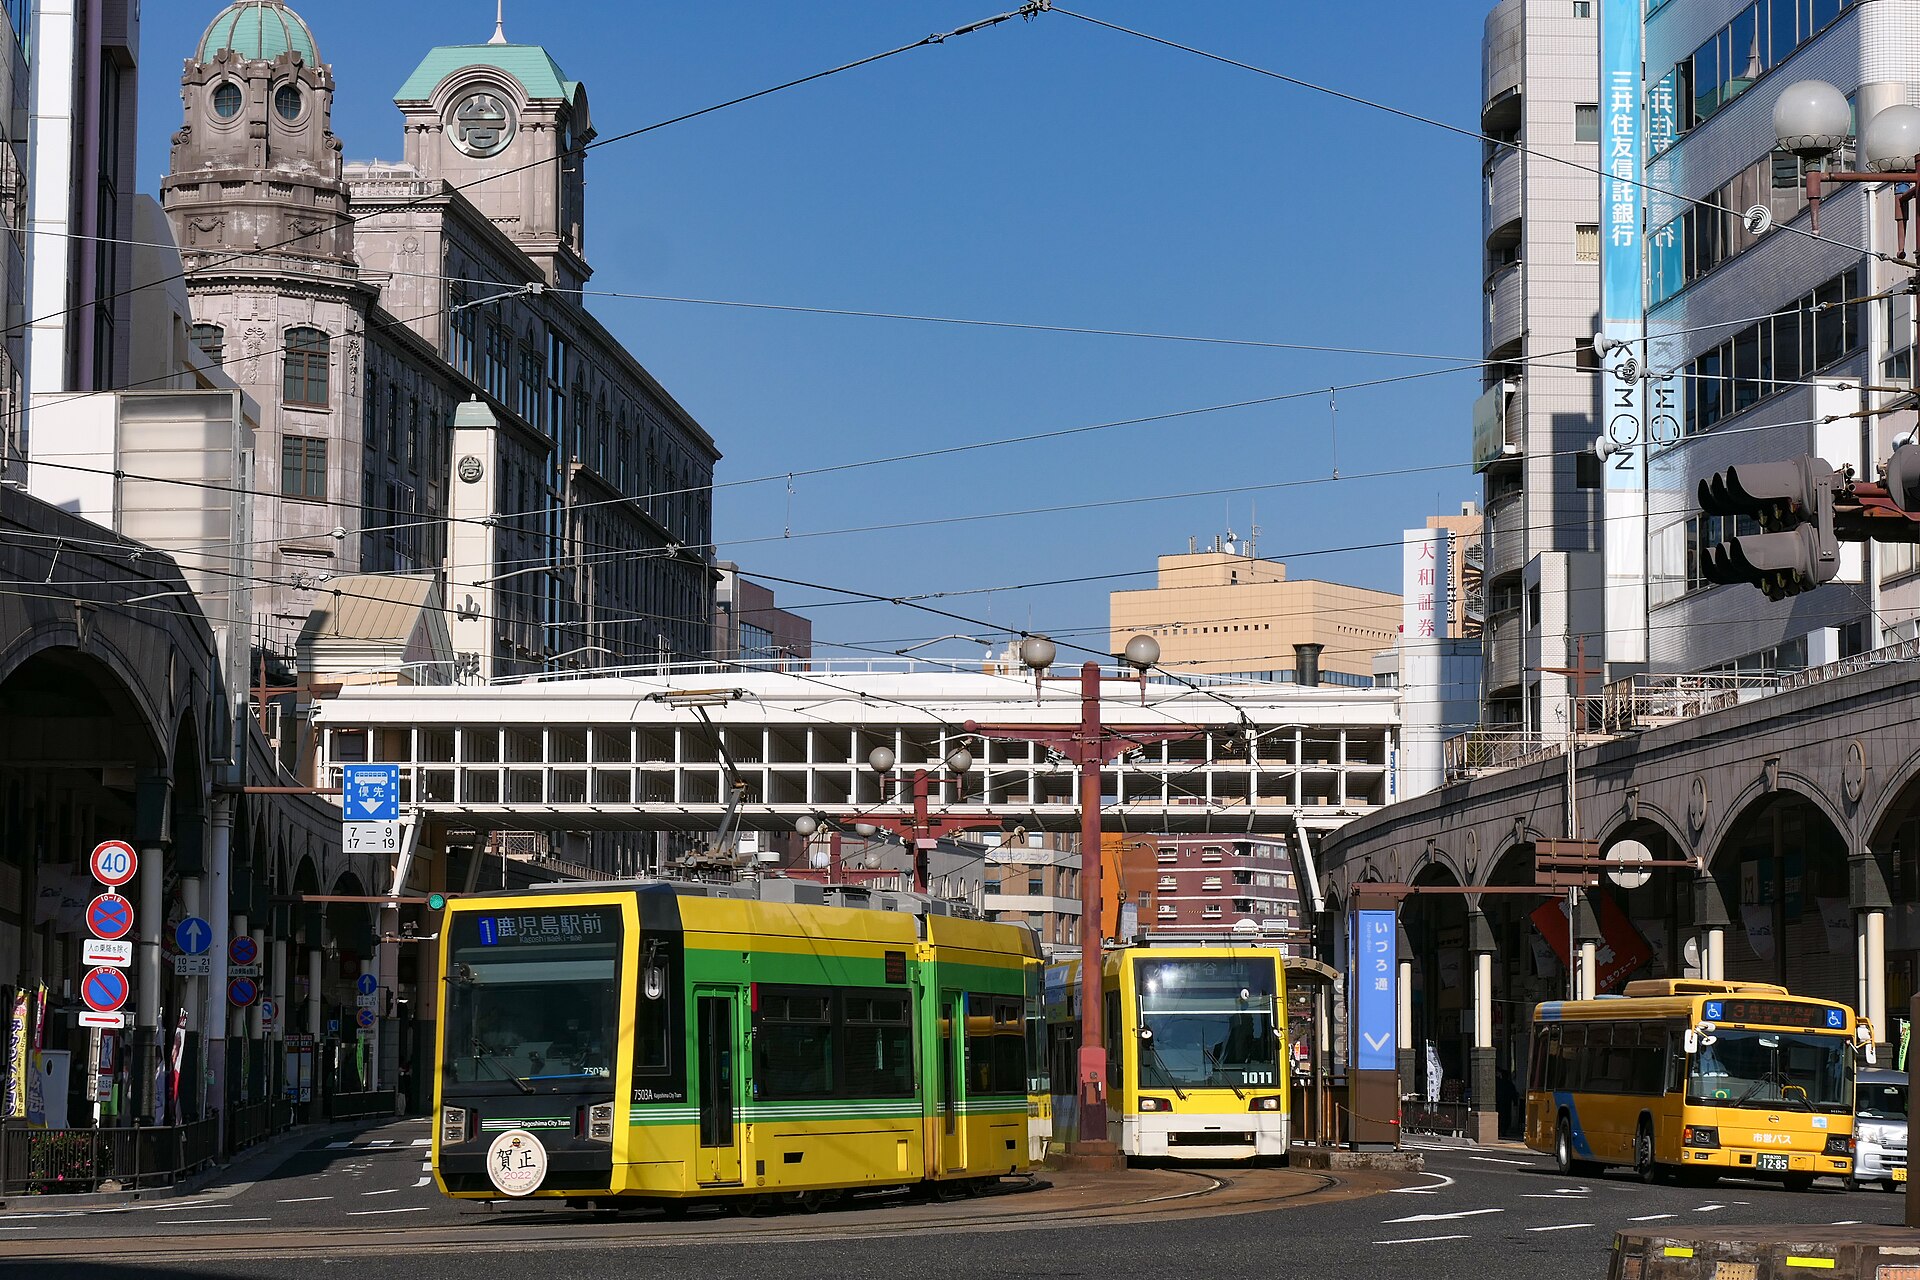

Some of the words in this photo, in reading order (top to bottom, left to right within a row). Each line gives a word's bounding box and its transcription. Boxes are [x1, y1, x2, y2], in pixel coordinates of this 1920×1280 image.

[1611, 71, 1634, 247] 三井住友信託銀行
[1418, 542, 1435, 637] 大和証券
[358, 786, 384, 798] 優先
[350, 827, 357, 837] 7
[385, 827, 392, 837] 9
[347, 838, 360, 849] 17
[382, 838, 395, 849] 19
[101, 853, 126, 873] 40
[497, 912, 602, 937] 鹿児島駅前
[88, 944, 128, 954] 人の乗降を除く
[1375, 921, 1388, 991] いづろ通
[1733, 1004, 1745, 1017] 3
[1241, 1071, 1273, 1084] 1011
[634, 1089, 653, 1100] 7503A
[521, 1120, 547, 1128] Kagoshima
[547, 1119, 557, 1127] City
[1753, 1133, 1792, 1144] 市営バス
[496, 1148, 536, 1172] 賀正
[503, 1171, 532, 1180] 2022
